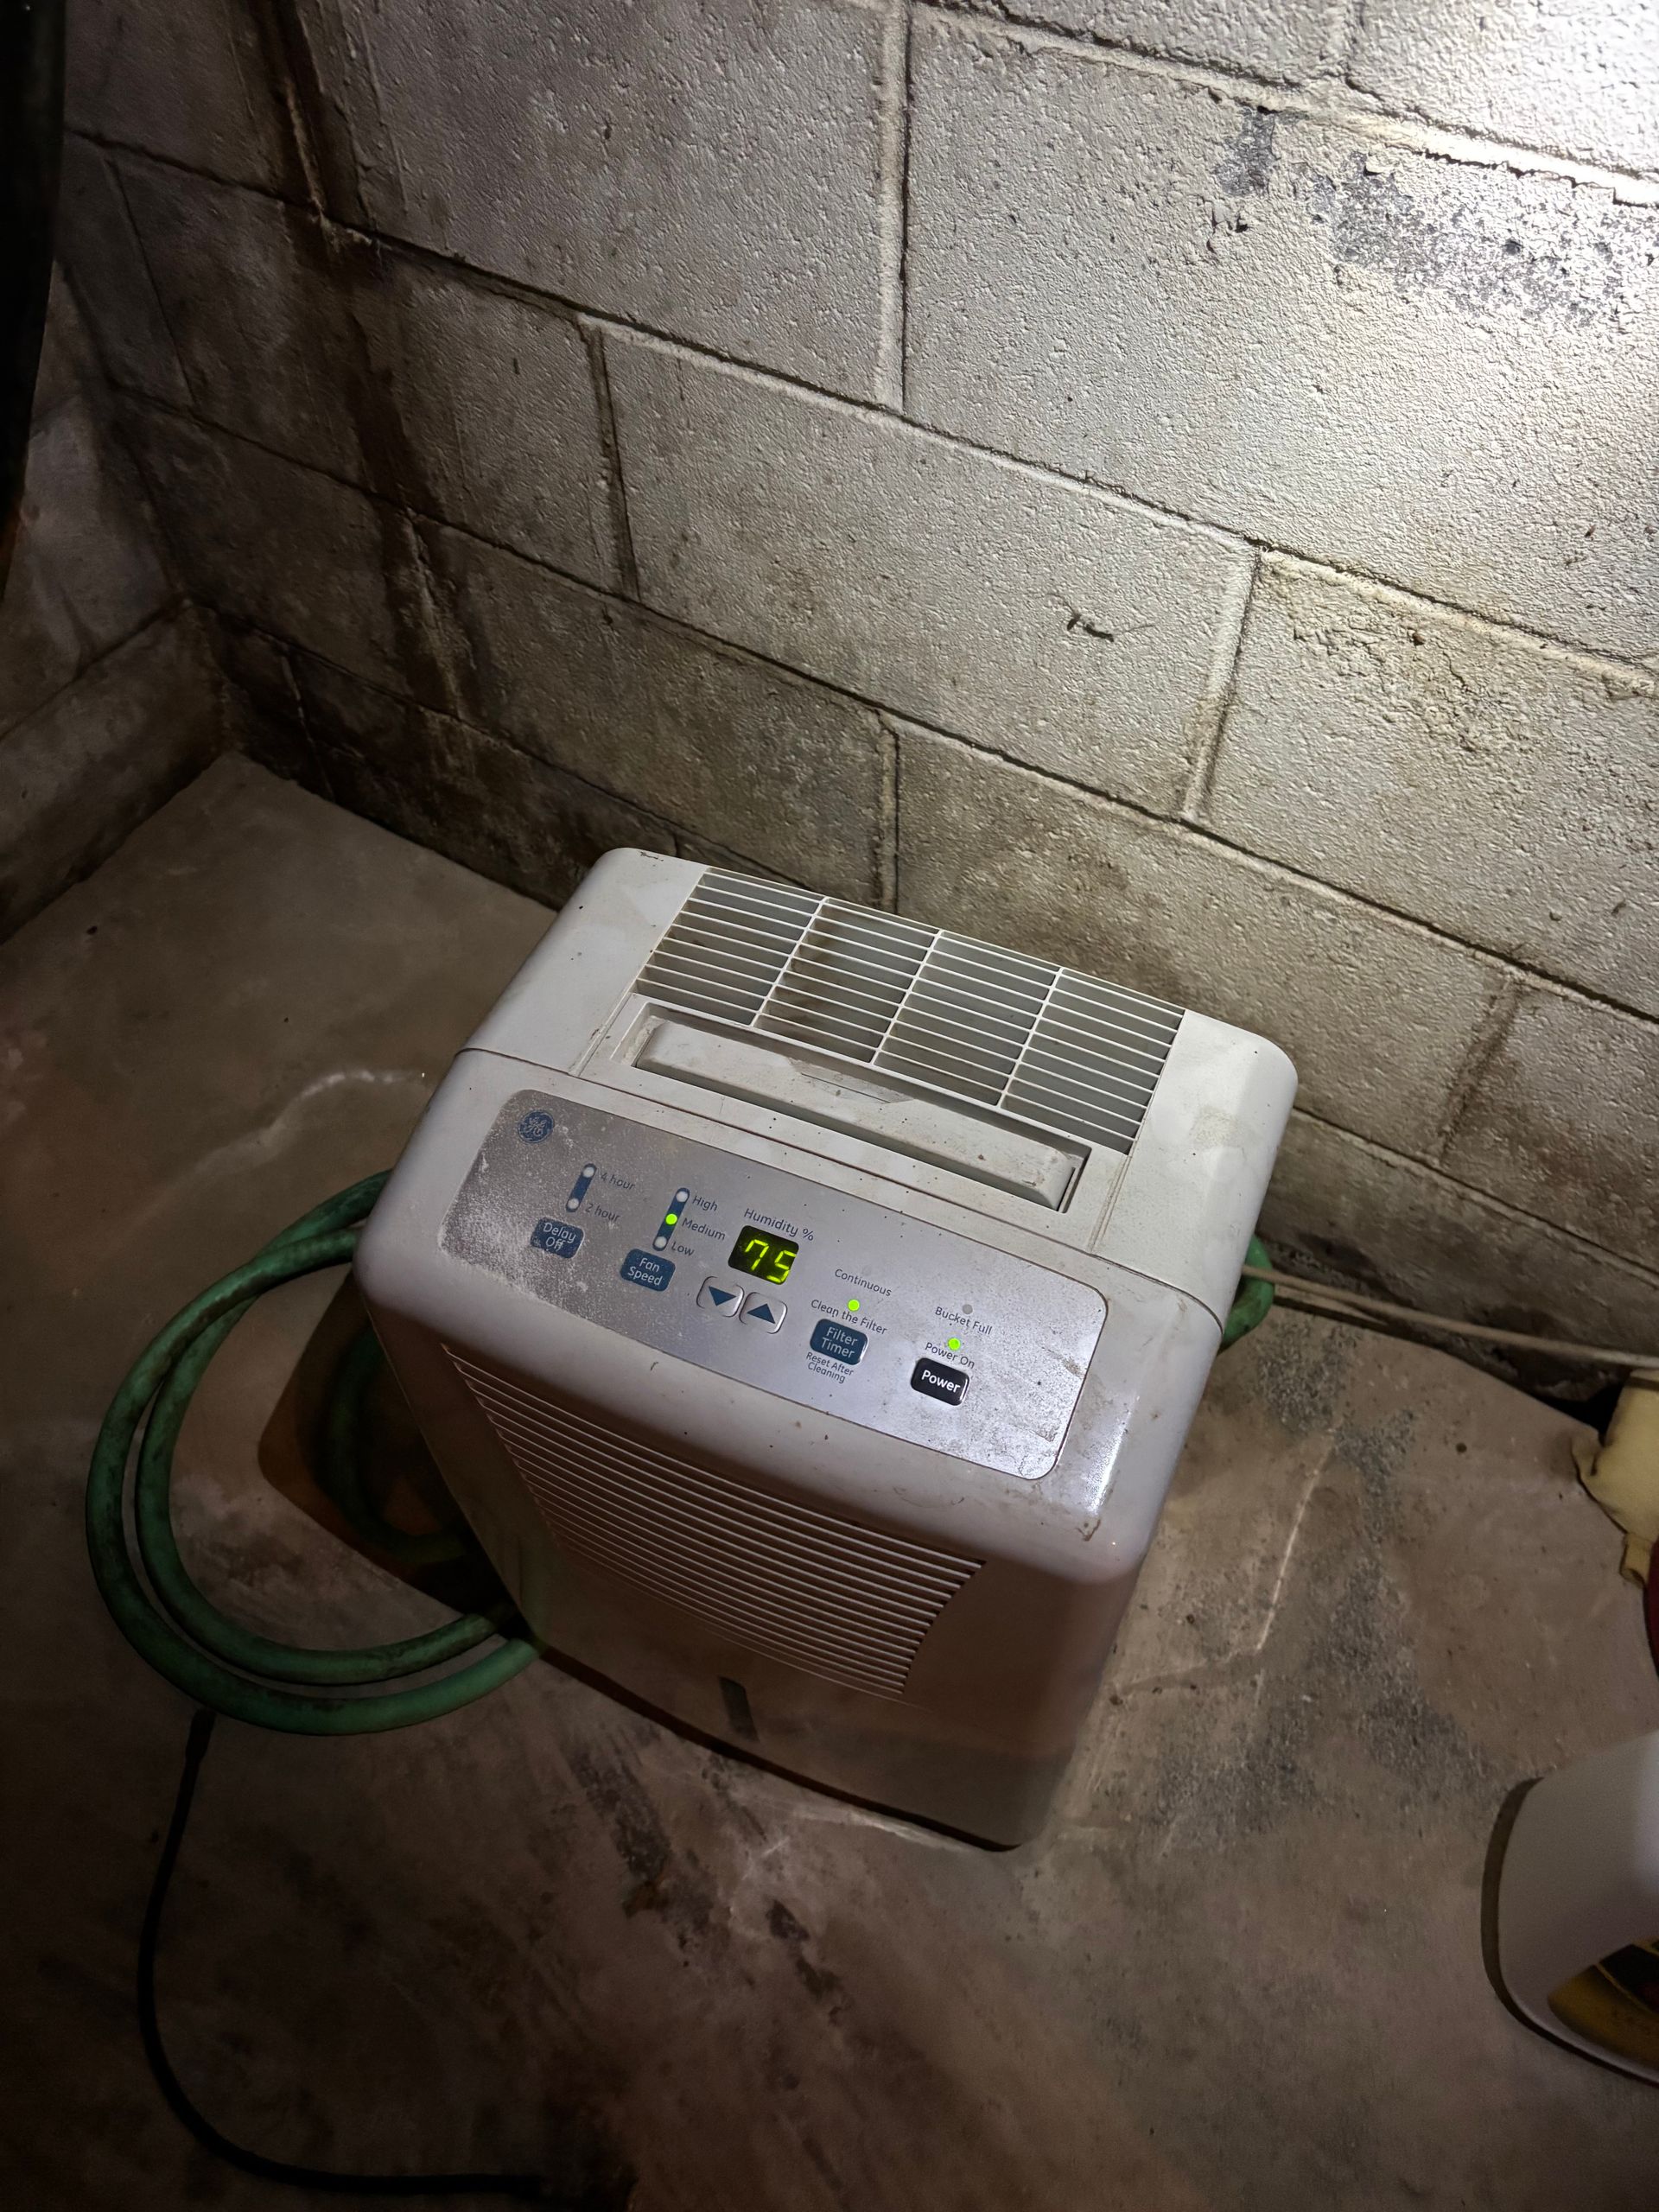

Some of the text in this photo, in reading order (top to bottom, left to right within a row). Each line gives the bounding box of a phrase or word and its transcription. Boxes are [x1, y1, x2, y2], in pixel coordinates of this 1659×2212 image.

[608, 1174, 636, 1190] hour
[585, 1203, 620, 1223] 2 hour
[692, 1195, 718, 1211] High
[543, 1222, 576, 1243] Delay
[681, 1217, 726, 1241] Medium
[743, 1207, 815, 1243] Humidity %
[545, 1236, 567, 1251] Off
[671, 1241, 695, 1256] Low
[639, 1258, 660, 1272] Fan
[745, 1239, 797, 1283] 75
[627, 1266, 664, 1286] Speed
[834, 1268, 892, 1297] Continuous
[810, 1299, 888, 1335] Clean the Filter
[935, 1306, 993, 1336] Bucket Full
[826, 1326, 858, 1345] Filter
[821, 1337, 855, 1358] Timer
[925, 1342, 976, 1370] Power On
[806, 1351, 854, 1376] Reset After
[808, 1362, 846, 1384] Cleaning
[920, 1370, 961, 1393] Power
